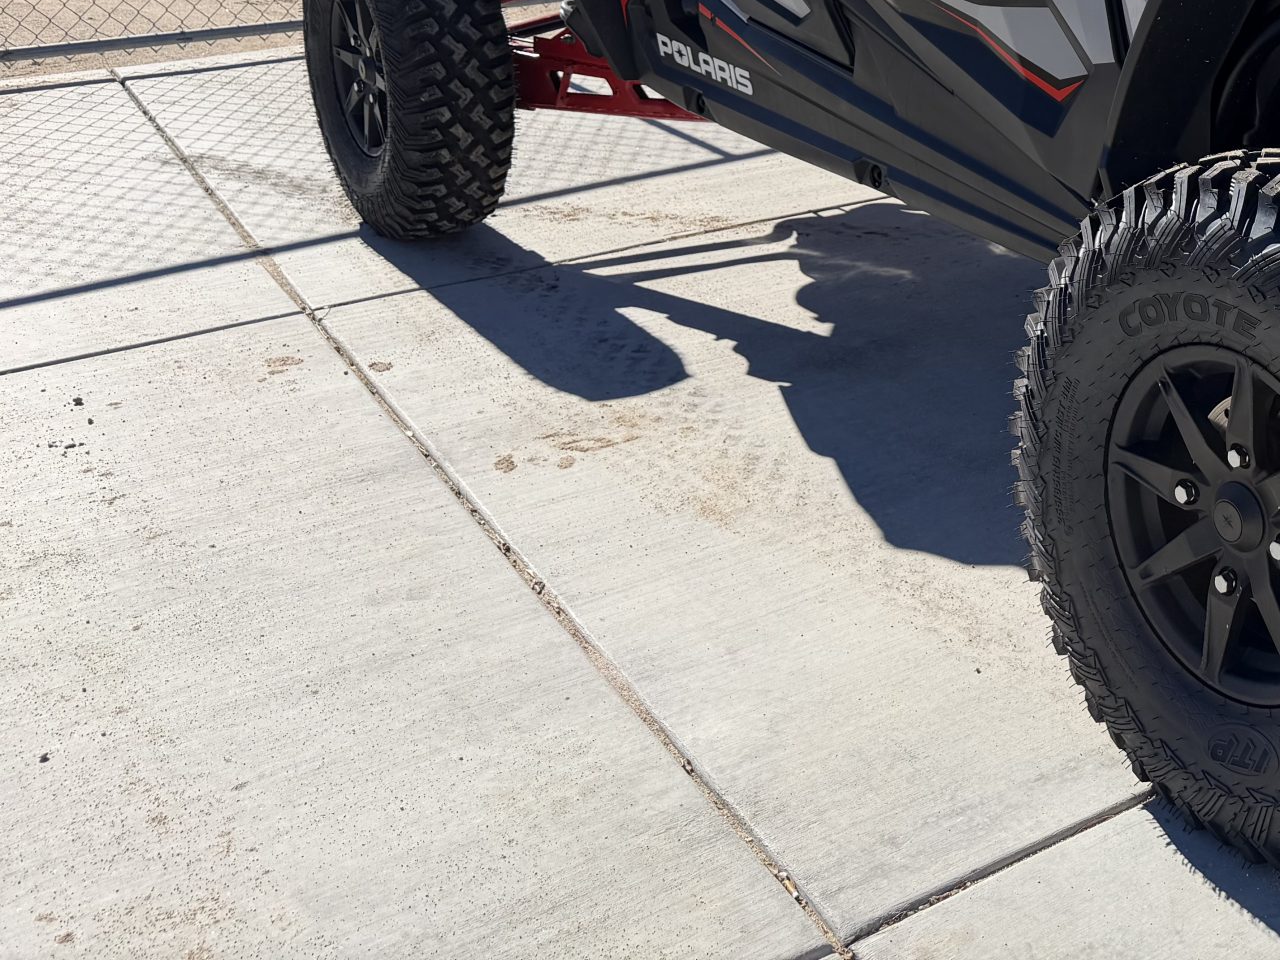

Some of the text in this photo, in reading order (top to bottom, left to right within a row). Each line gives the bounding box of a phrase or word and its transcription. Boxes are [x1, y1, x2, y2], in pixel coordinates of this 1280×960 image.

[656, 32, 754, 96] POLARIS
[1118, 292, 1262, 341] COYOTE
[1209, 732, 1272, 774] ITP
